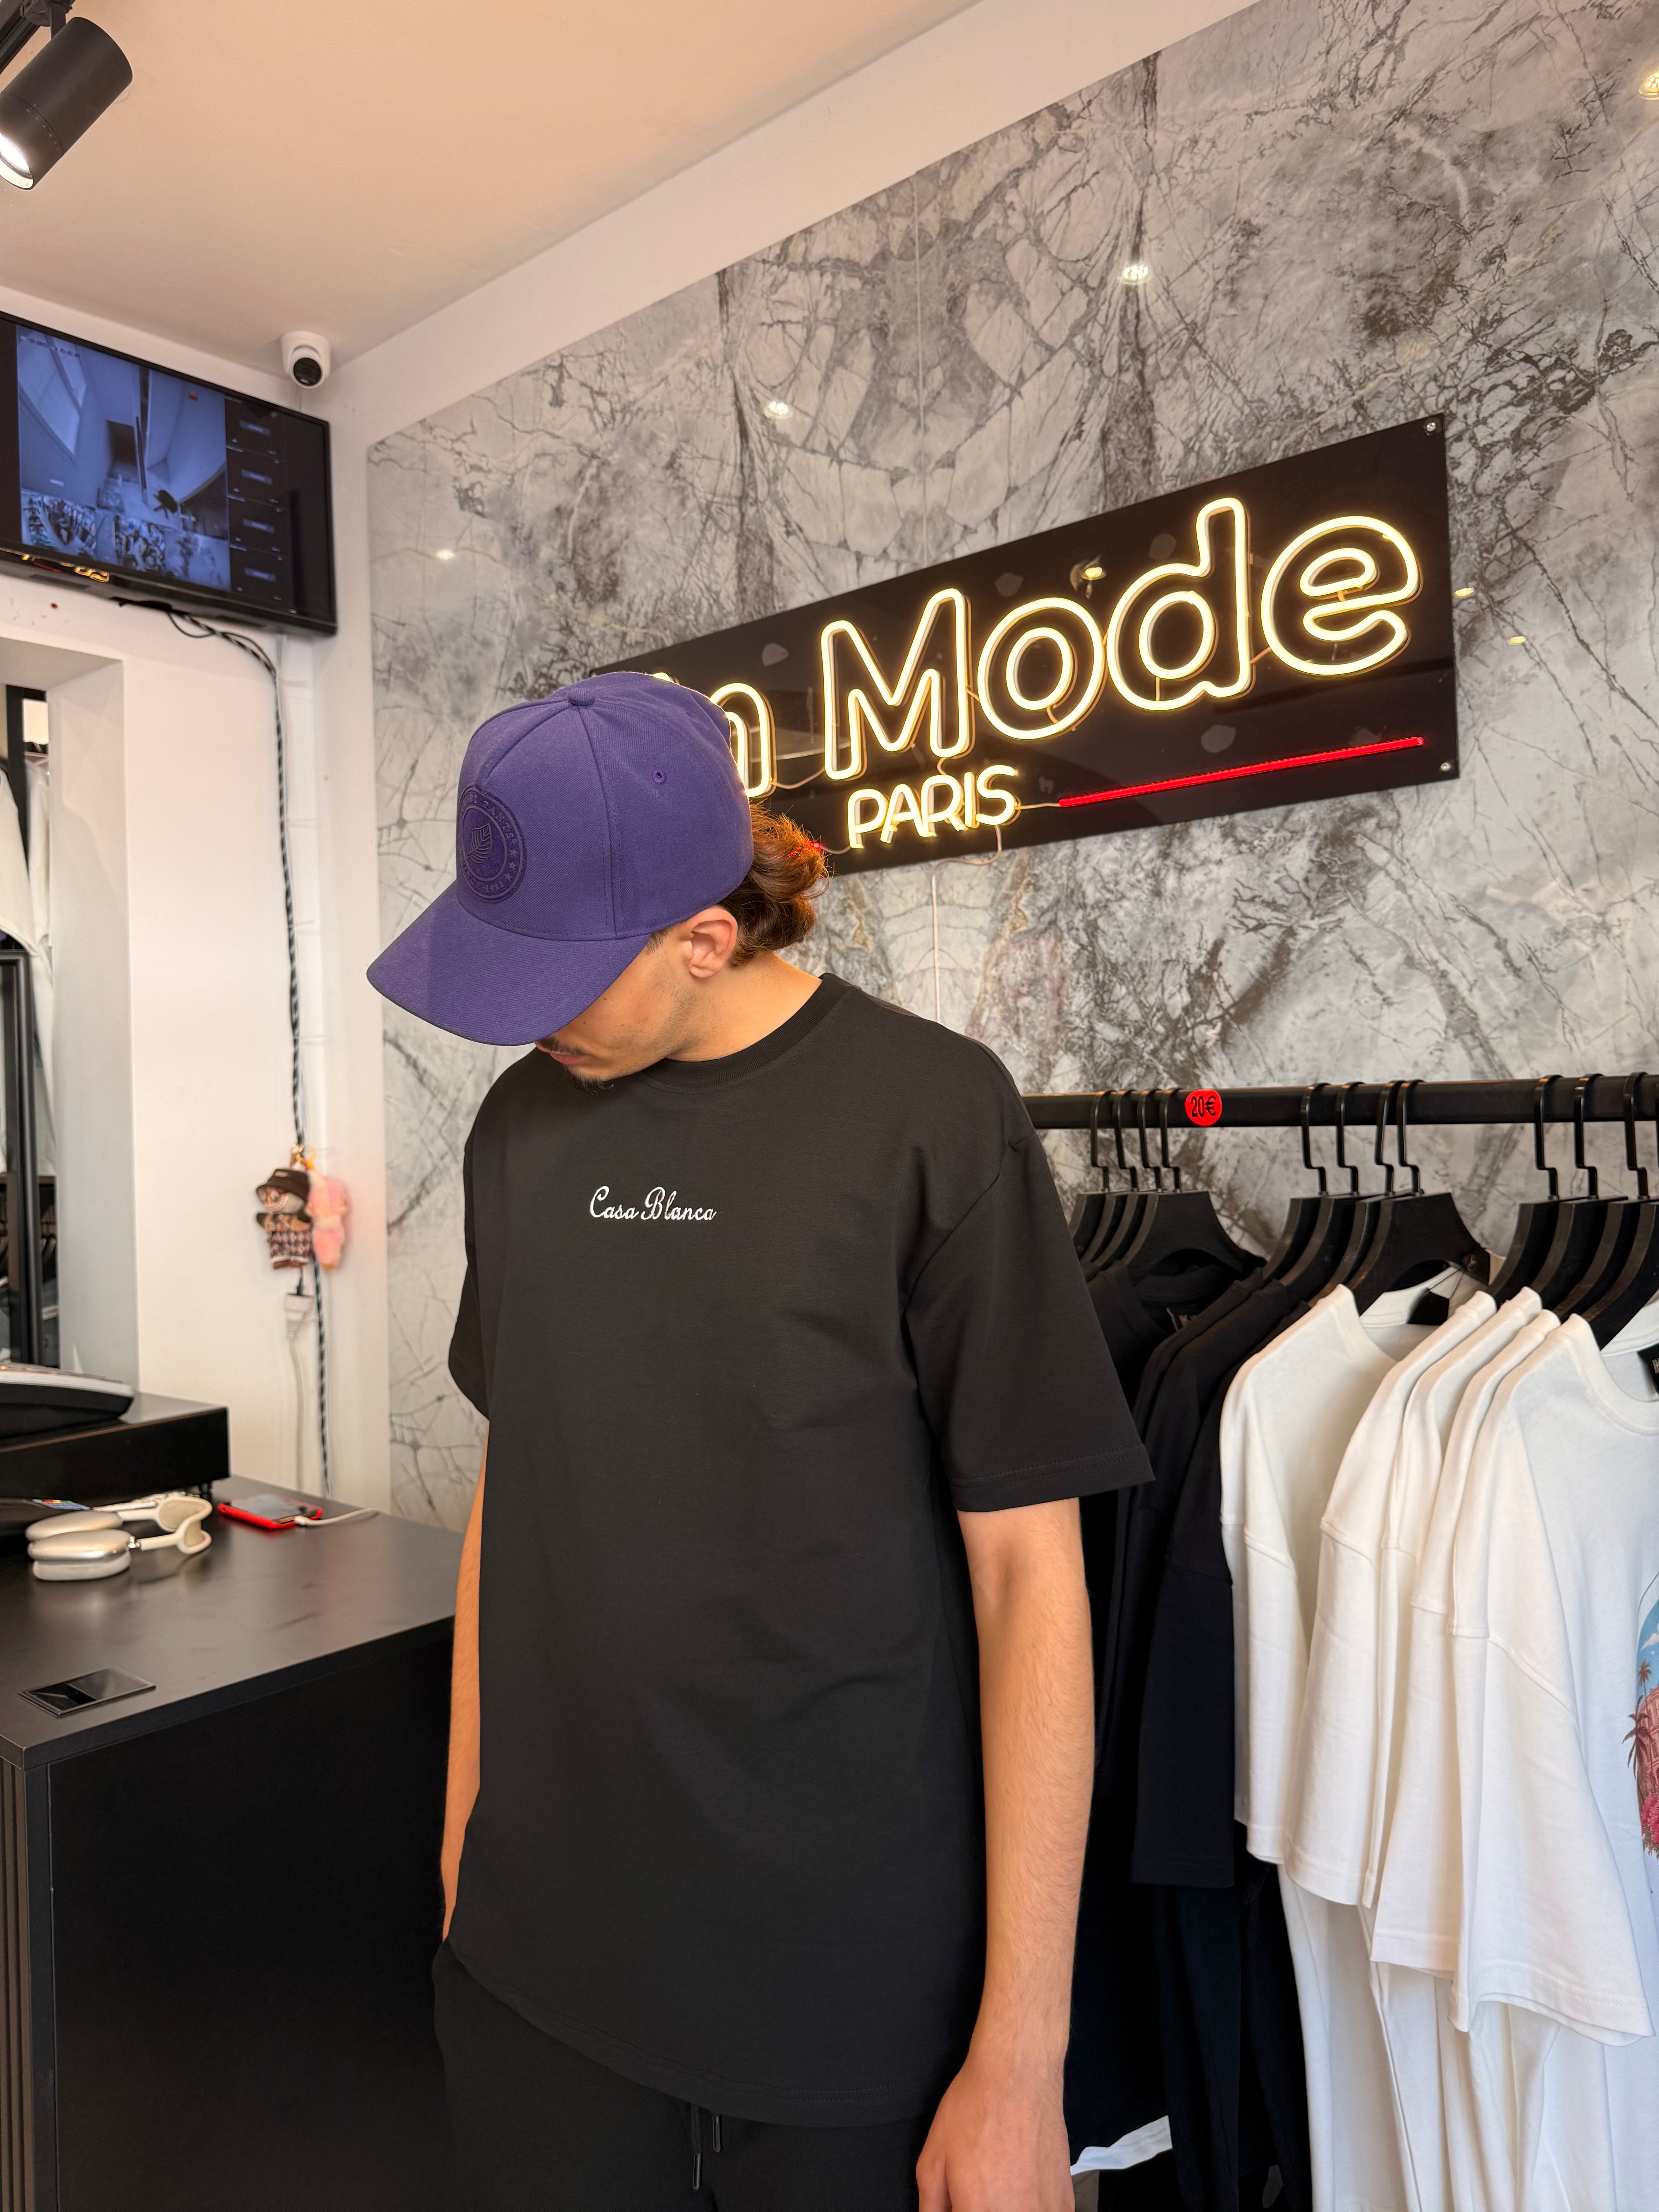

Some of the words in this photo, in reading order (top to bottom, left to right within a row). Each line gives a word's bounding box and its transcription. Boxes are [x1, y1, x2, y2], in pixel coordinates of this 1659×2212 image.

[821, 497, 1419, 780] Mode
[847, 764, 1018, 849] PARIS
[1190, 1095, 1217, 1117] 20€
[589, 1185, 640, 1220] Casa
[640, 1187, 717, 1221] Blanca
